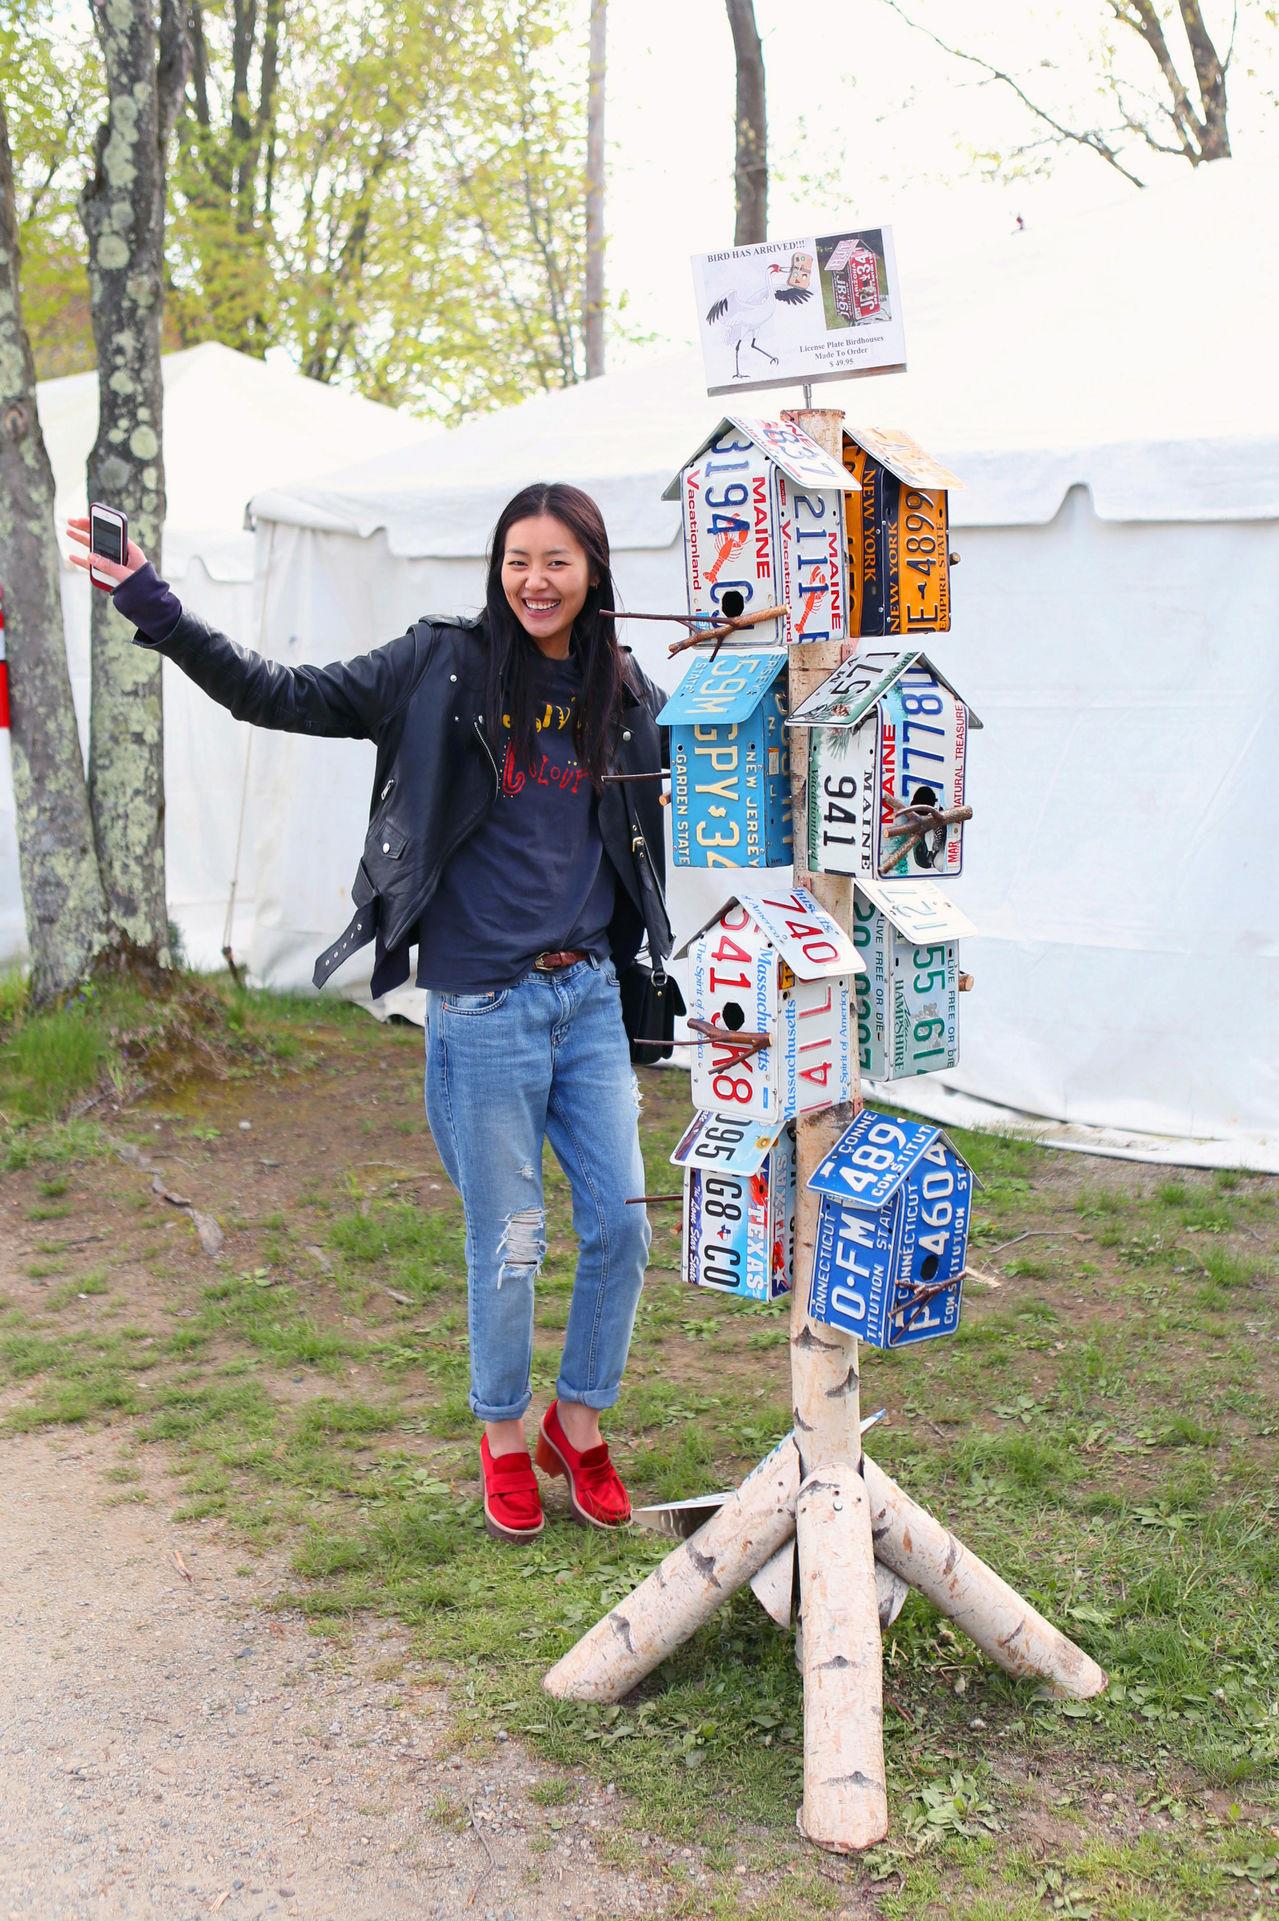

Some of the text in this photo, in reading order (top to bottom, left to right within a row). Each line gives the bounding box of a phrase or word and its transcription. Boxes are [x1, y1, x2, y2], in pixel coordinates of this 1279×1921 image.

[707, 240, 805, 262] BIRD HAS ARRIVED!!!
[836, 358, 854, 366] 49.95
[846, 336, 884, 346] Birdhouses
[687, 469, 701, 590] Vacationland
[753, 477, 770, 580] MAINE
[864, 470, 876, 582] NEW YORK
[905, 490, 936, 576] 4899
[828, 532, 841, 630] MAINE
[888, 521, 900, 632] NEW YORK
[936, 522, 947, 631] EMPIRE STATE
[954, 704, 964, 759] TREASURE
[675, 754, 690, 865] GARDEN STATE
[745, 751, 759, 868] NEW JERSEY
[881, 724, 896, 824] MAINE
[810, 769, 819, 861] Vacationland
[861, 770, 873, 870] MAINE
[947, 841, 958, 863] MAR
[696, 943, 706, 963] The
[762, 895, 840, 964] 740
[694, 966, 706, 997] Spirit
[695, 999, 705, 1010] of
[875, 919, 884, 1032] LIVE FREE OR DIE
[947, 959, 955, 983] LIVE
[839, 989, 847, 1037] America
[839, 1041, 848, 1050] of
[895, 980, 904, 1072] HAMPSHIRE
[948, 1027, 955, 1043] OR
[783, 999, 797, 1120] Massachusetts
[839, 1055, 849, 1083] Spirit
[947, 1050, 955, 1068] DIE
[690, 1198, 700, 1224] Lone
[775, 1152, 786, 1242] TEXAS
[689, 1253, 699, 1282] State
[690, 1227, 699, 1250] Star
[746, 1205, 764, 1290] TEXAS
[812, 1211, 837, 1323] CONNECTICUT
